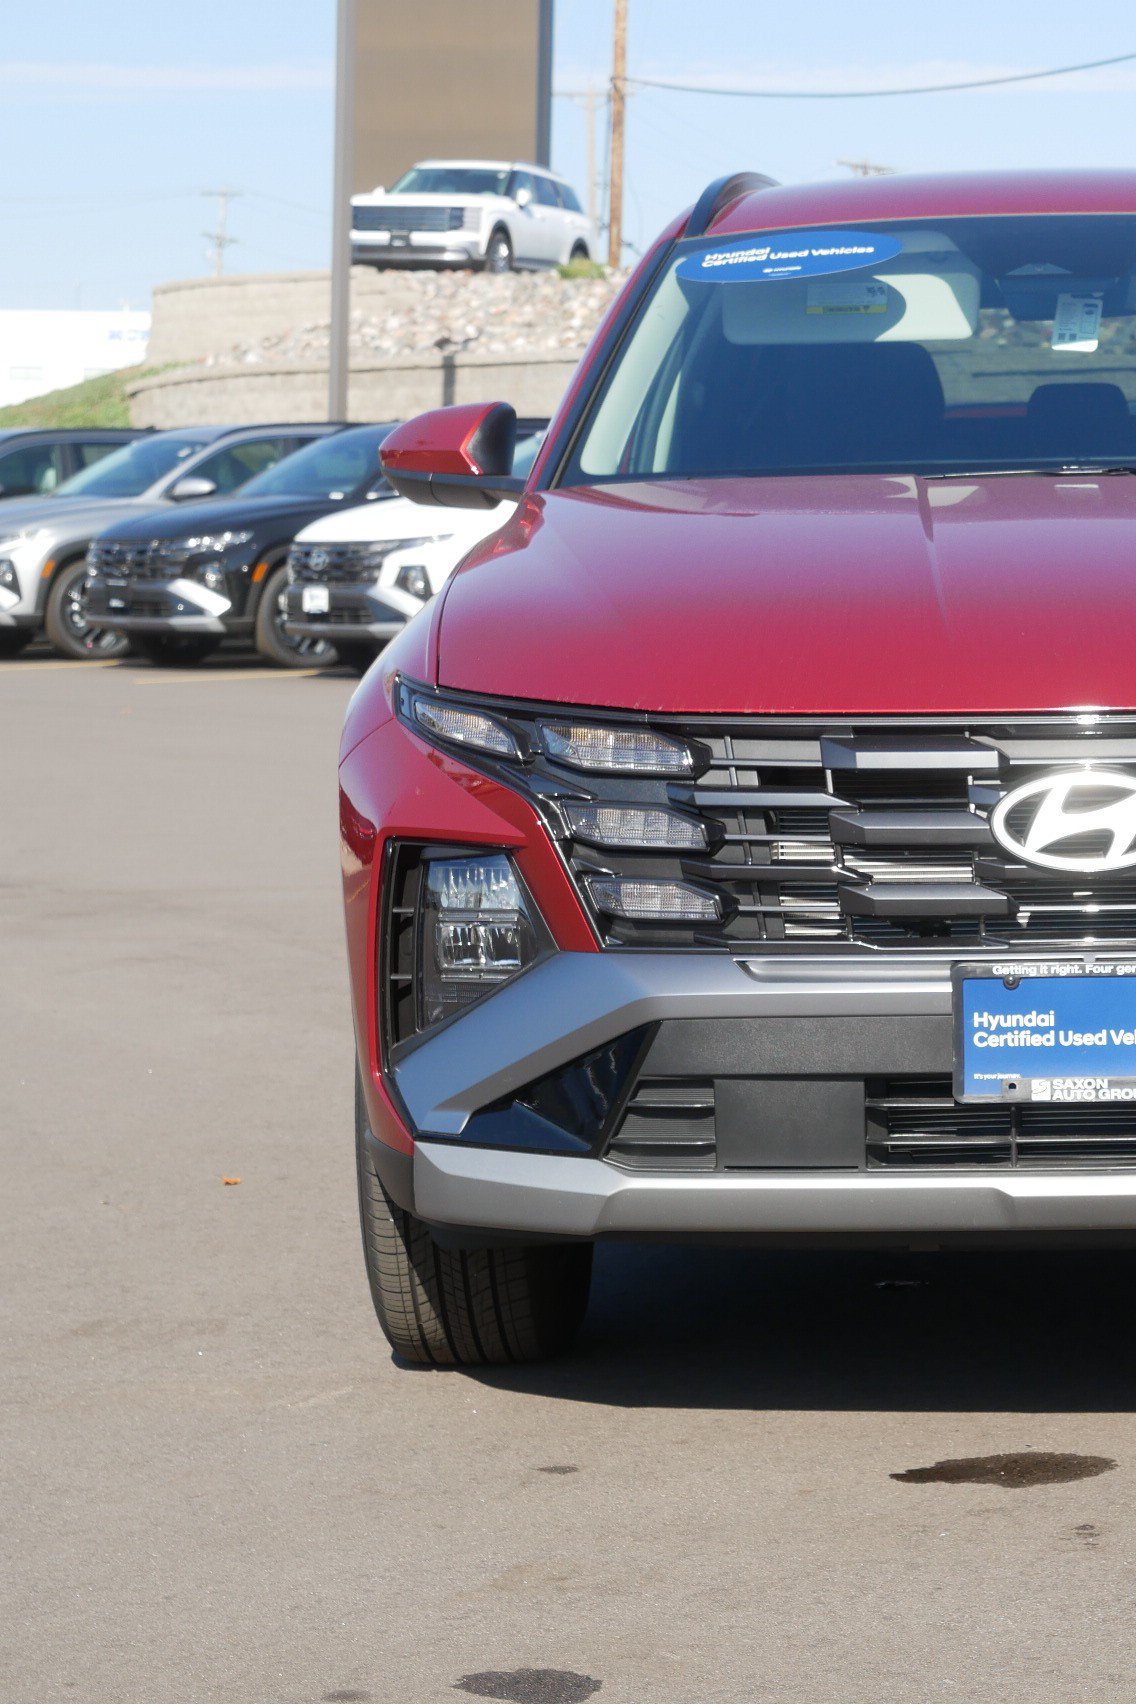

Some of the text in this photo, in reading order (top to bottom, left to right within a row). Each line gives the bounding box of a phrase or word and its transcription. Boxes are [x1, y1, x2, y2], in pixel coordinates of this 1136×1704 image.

[702, 246, 875, 268] Certified Used Vehicles
[705, 247, 770, 262] Hyundai
[992, 964, 1037, 976] Getting
[1039, 964, 1048, 974] it
[1051, 964, 1083, 976] right.
[1085, 963, 1114, 974] Four
[973, 1010, 1055, 1031] Hyundai
[973, 1030, 1055, 1047] Certified
[1059, 1029, 1107, 1046] Used
[1052, 1078, 1108, 1090] SAXON
[1052, 1088, 1096, 1101] AUTO
